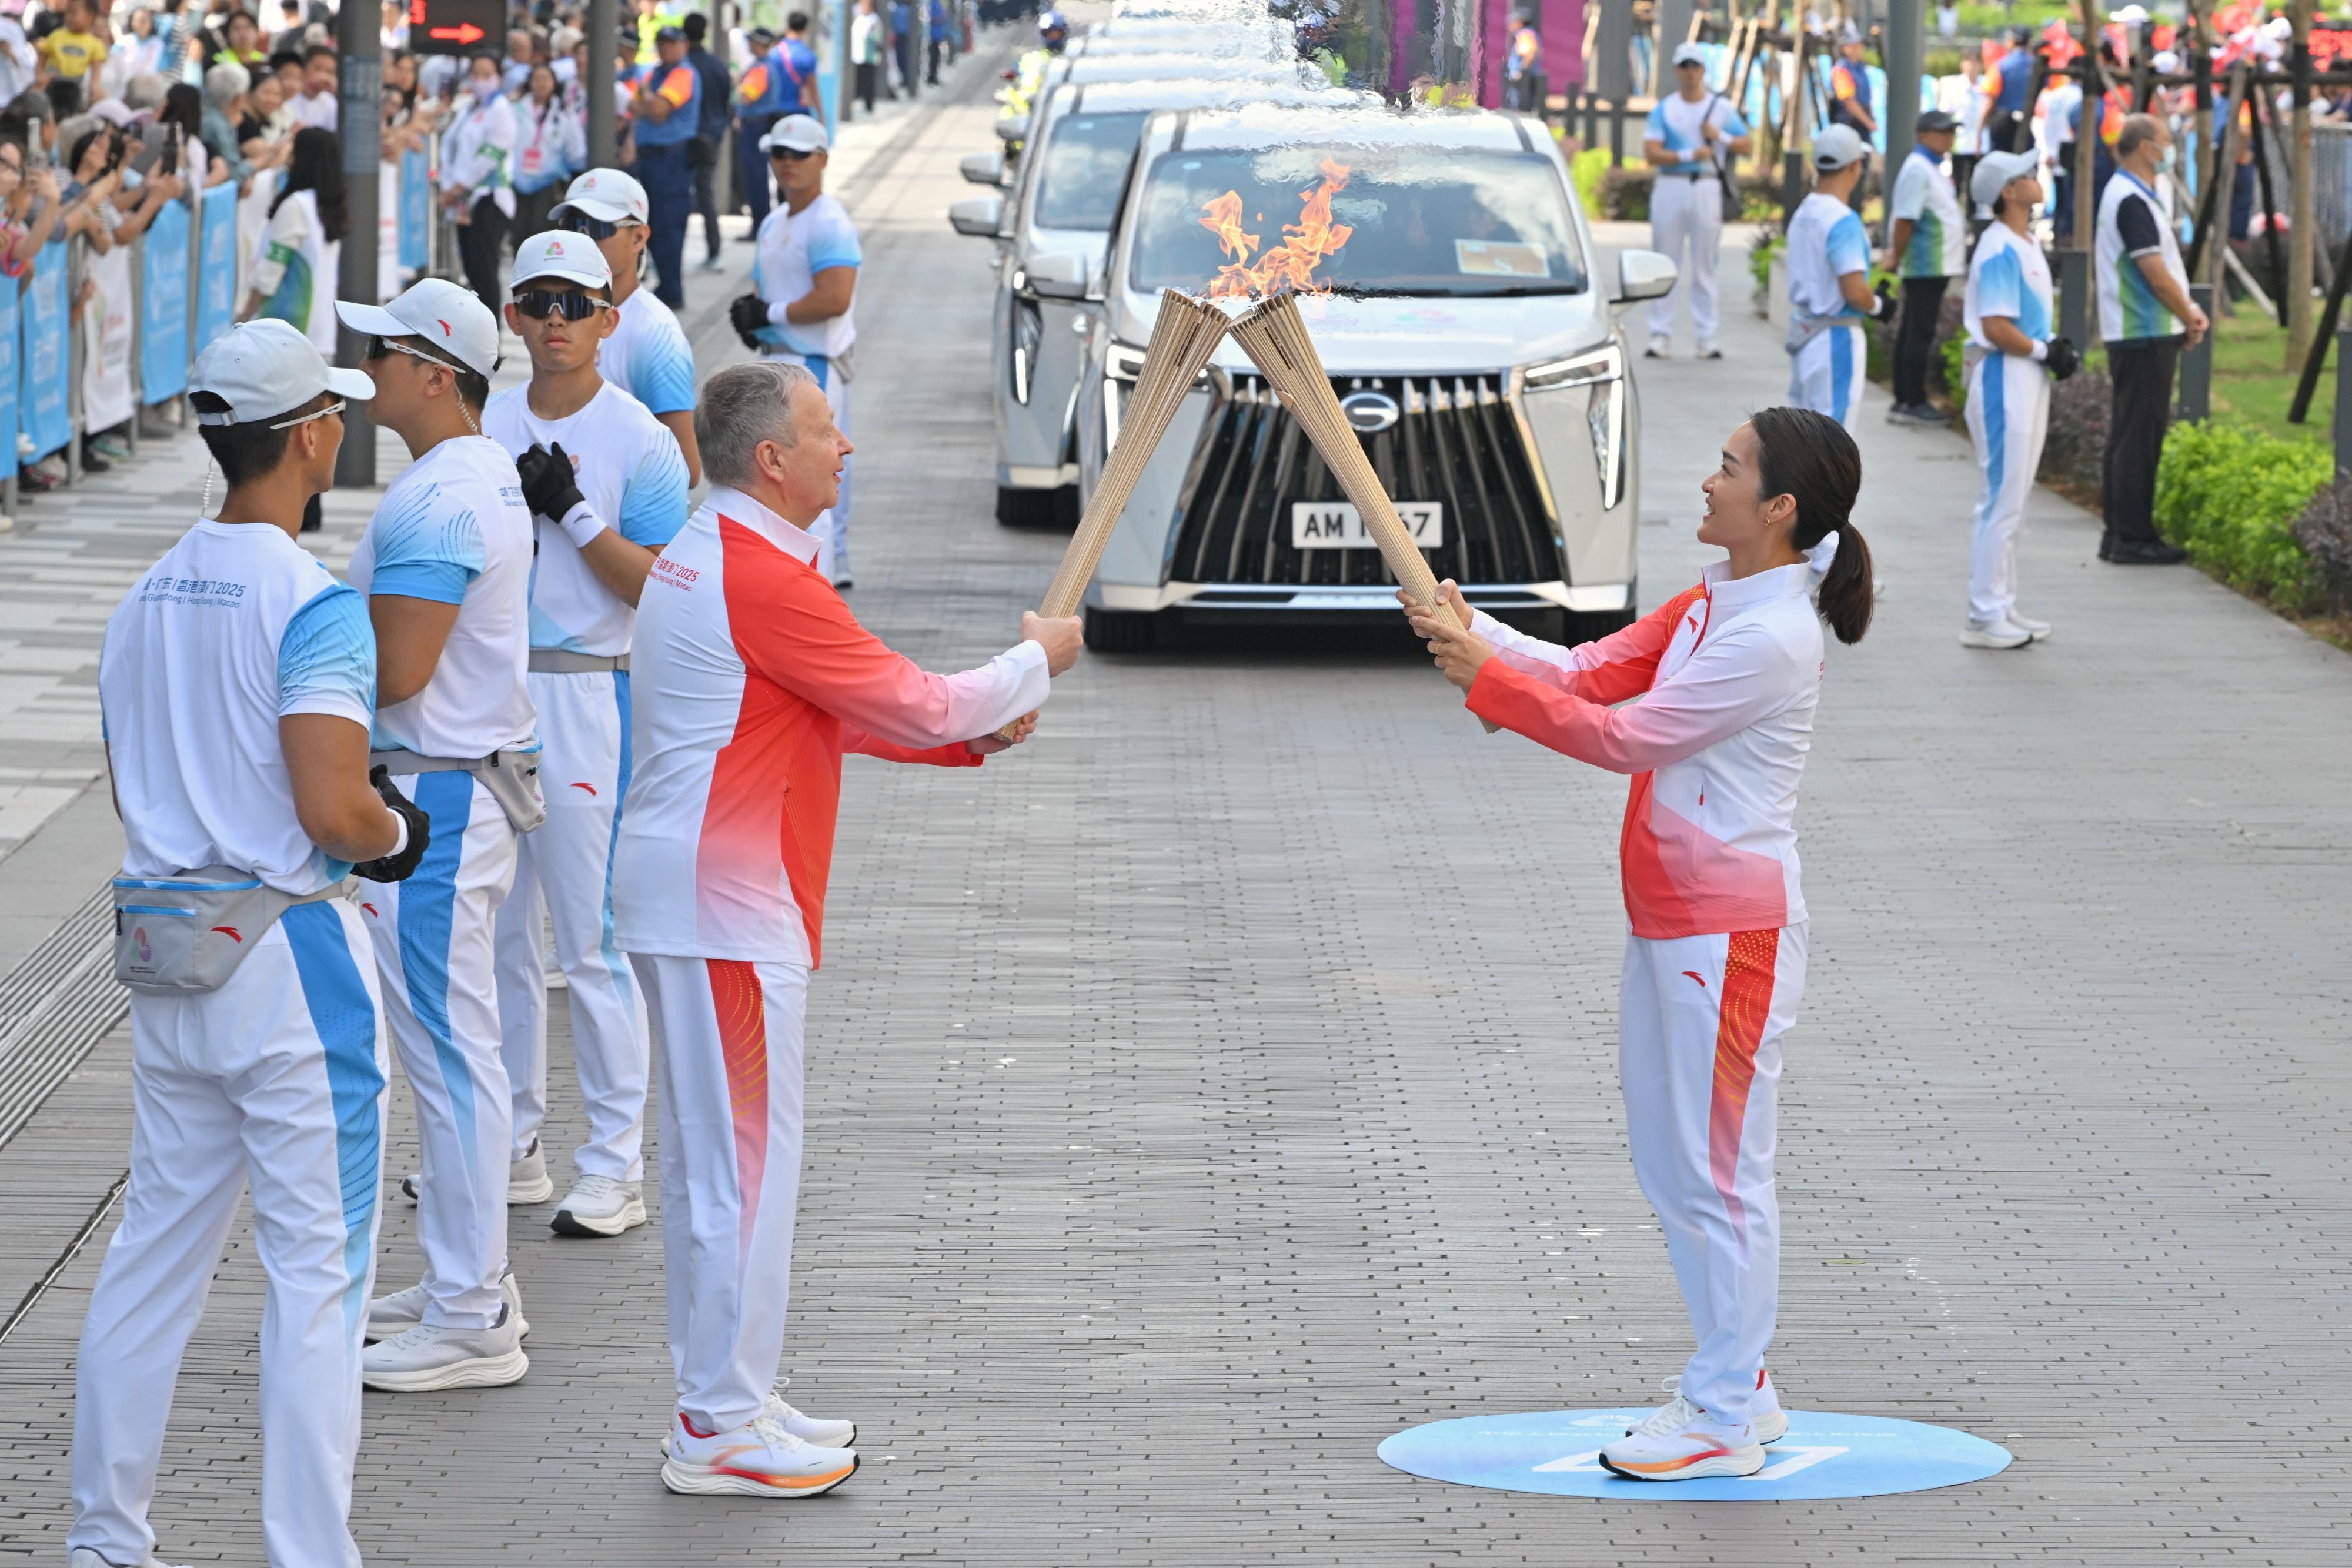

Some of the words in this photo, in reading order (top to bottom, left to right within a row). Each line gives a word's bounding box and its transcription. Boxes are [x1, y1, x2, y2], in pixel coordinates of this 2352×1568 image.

[1304, 513, 1344, 537] AM
[676, 579, 692, 592] Macao
[216, 597, 240, 608] Macao
